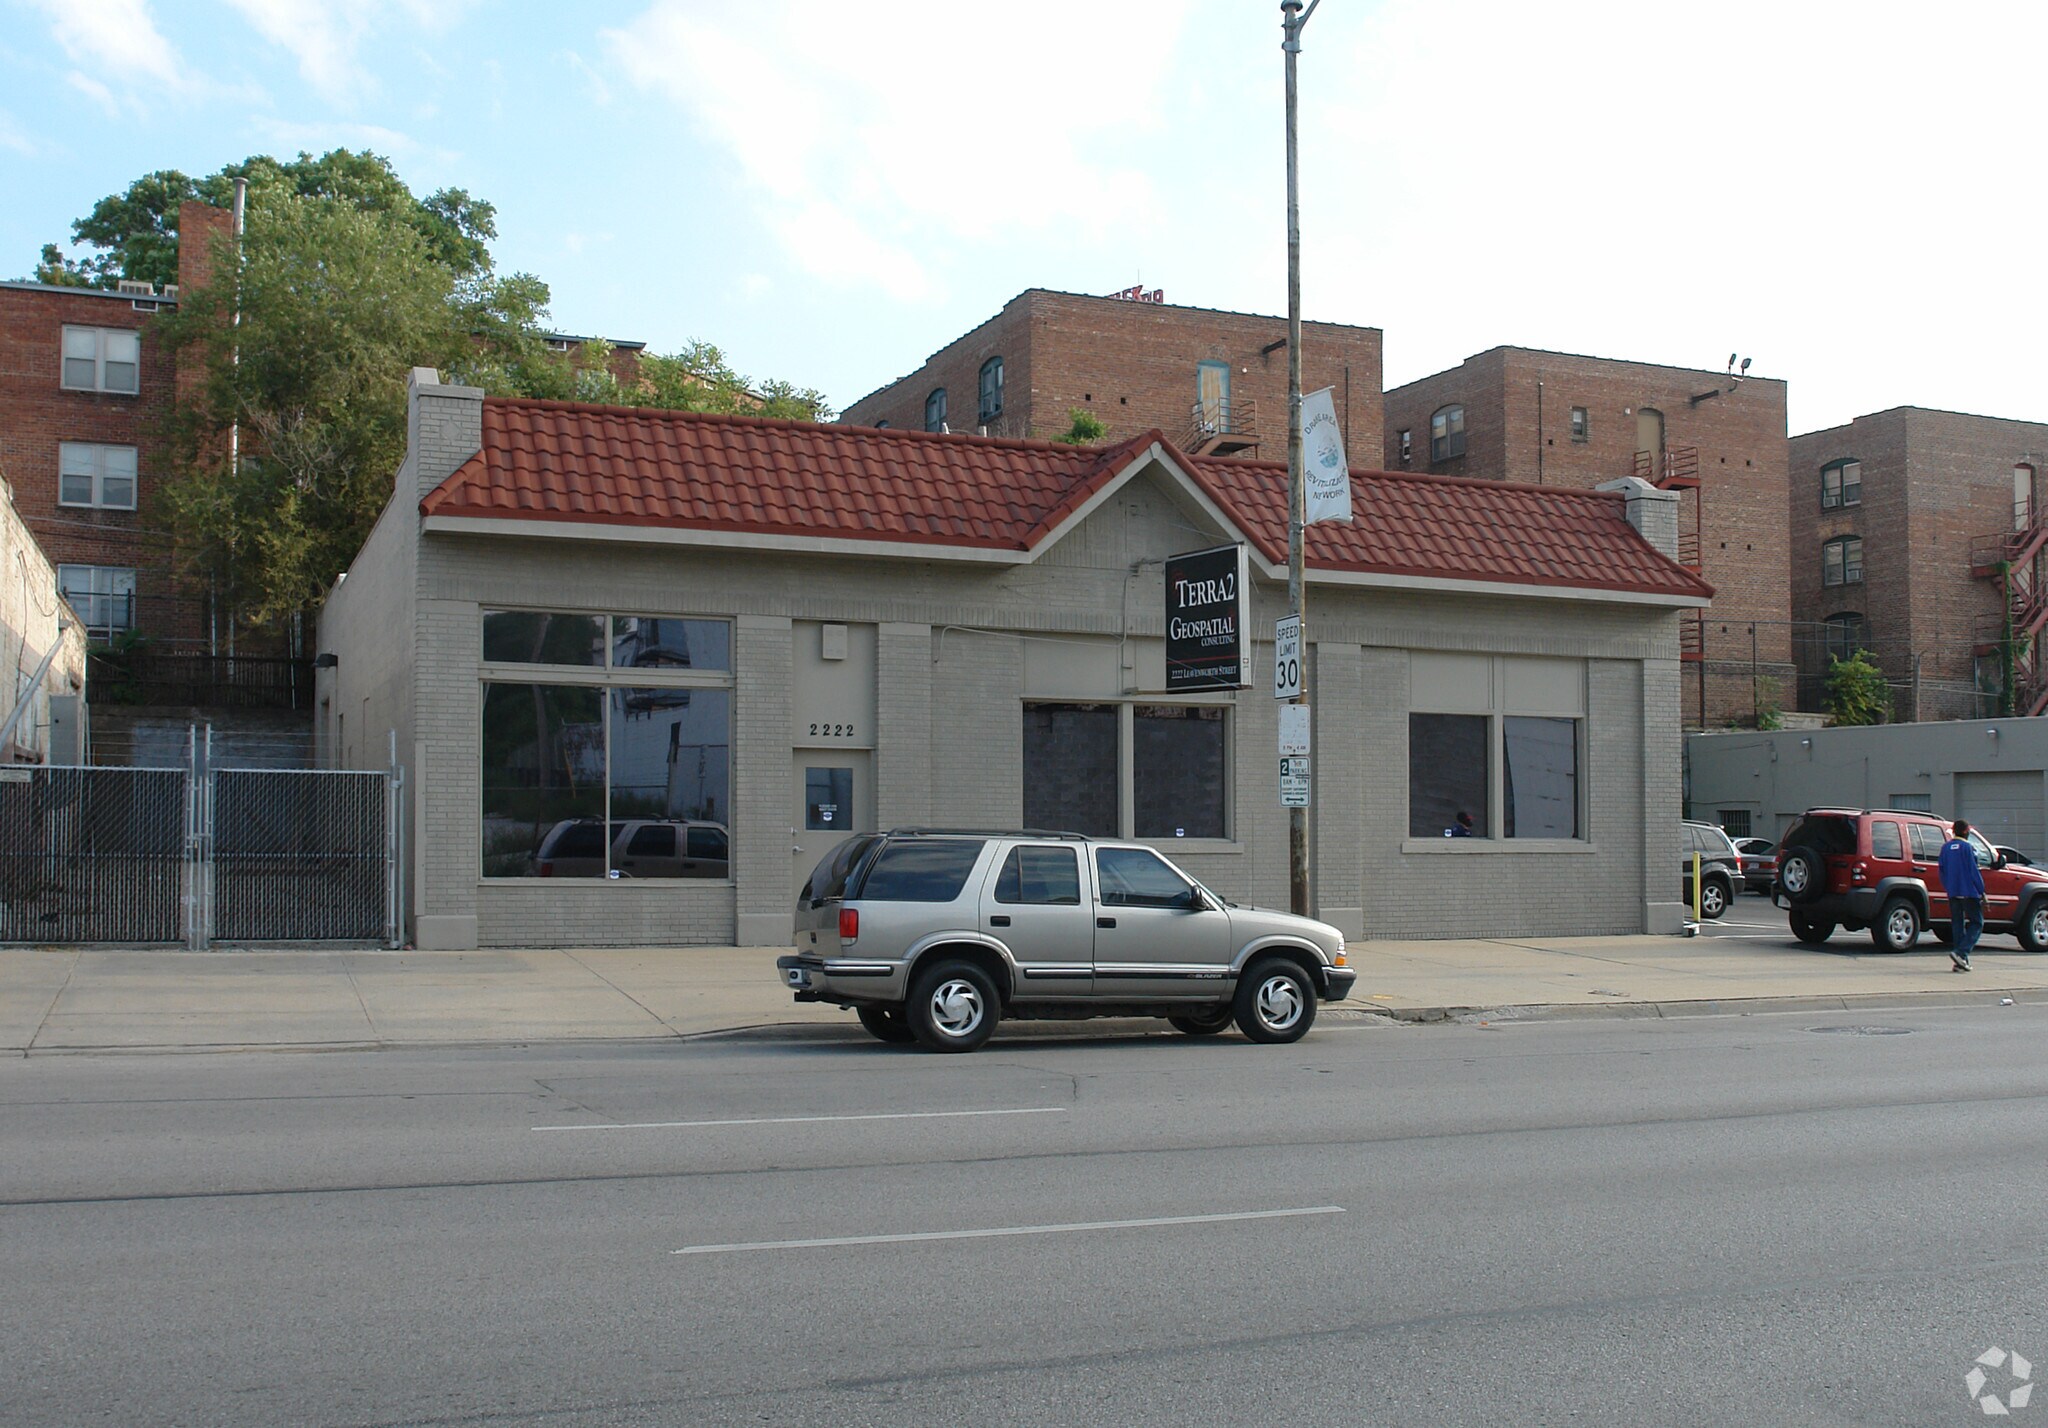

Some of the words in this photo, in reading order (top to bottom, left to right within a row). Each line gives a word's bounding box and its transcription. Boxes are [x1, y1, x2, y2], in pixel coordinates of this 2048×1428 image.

[1175, 572, 1235, 608] TERRA2
[1170, 617, 1235, 641] GEOSPATIAL
[1277, 625, 1299, 641] SPEED
[1201, 634, 1235, 647] CONSULTING
[1279, 642, 1296, 657] LIMIT
[1277, 658, 1298, 689] 30
[809, 723, 854, 737] 2222
[1281, 761, 1288, 774] 2
